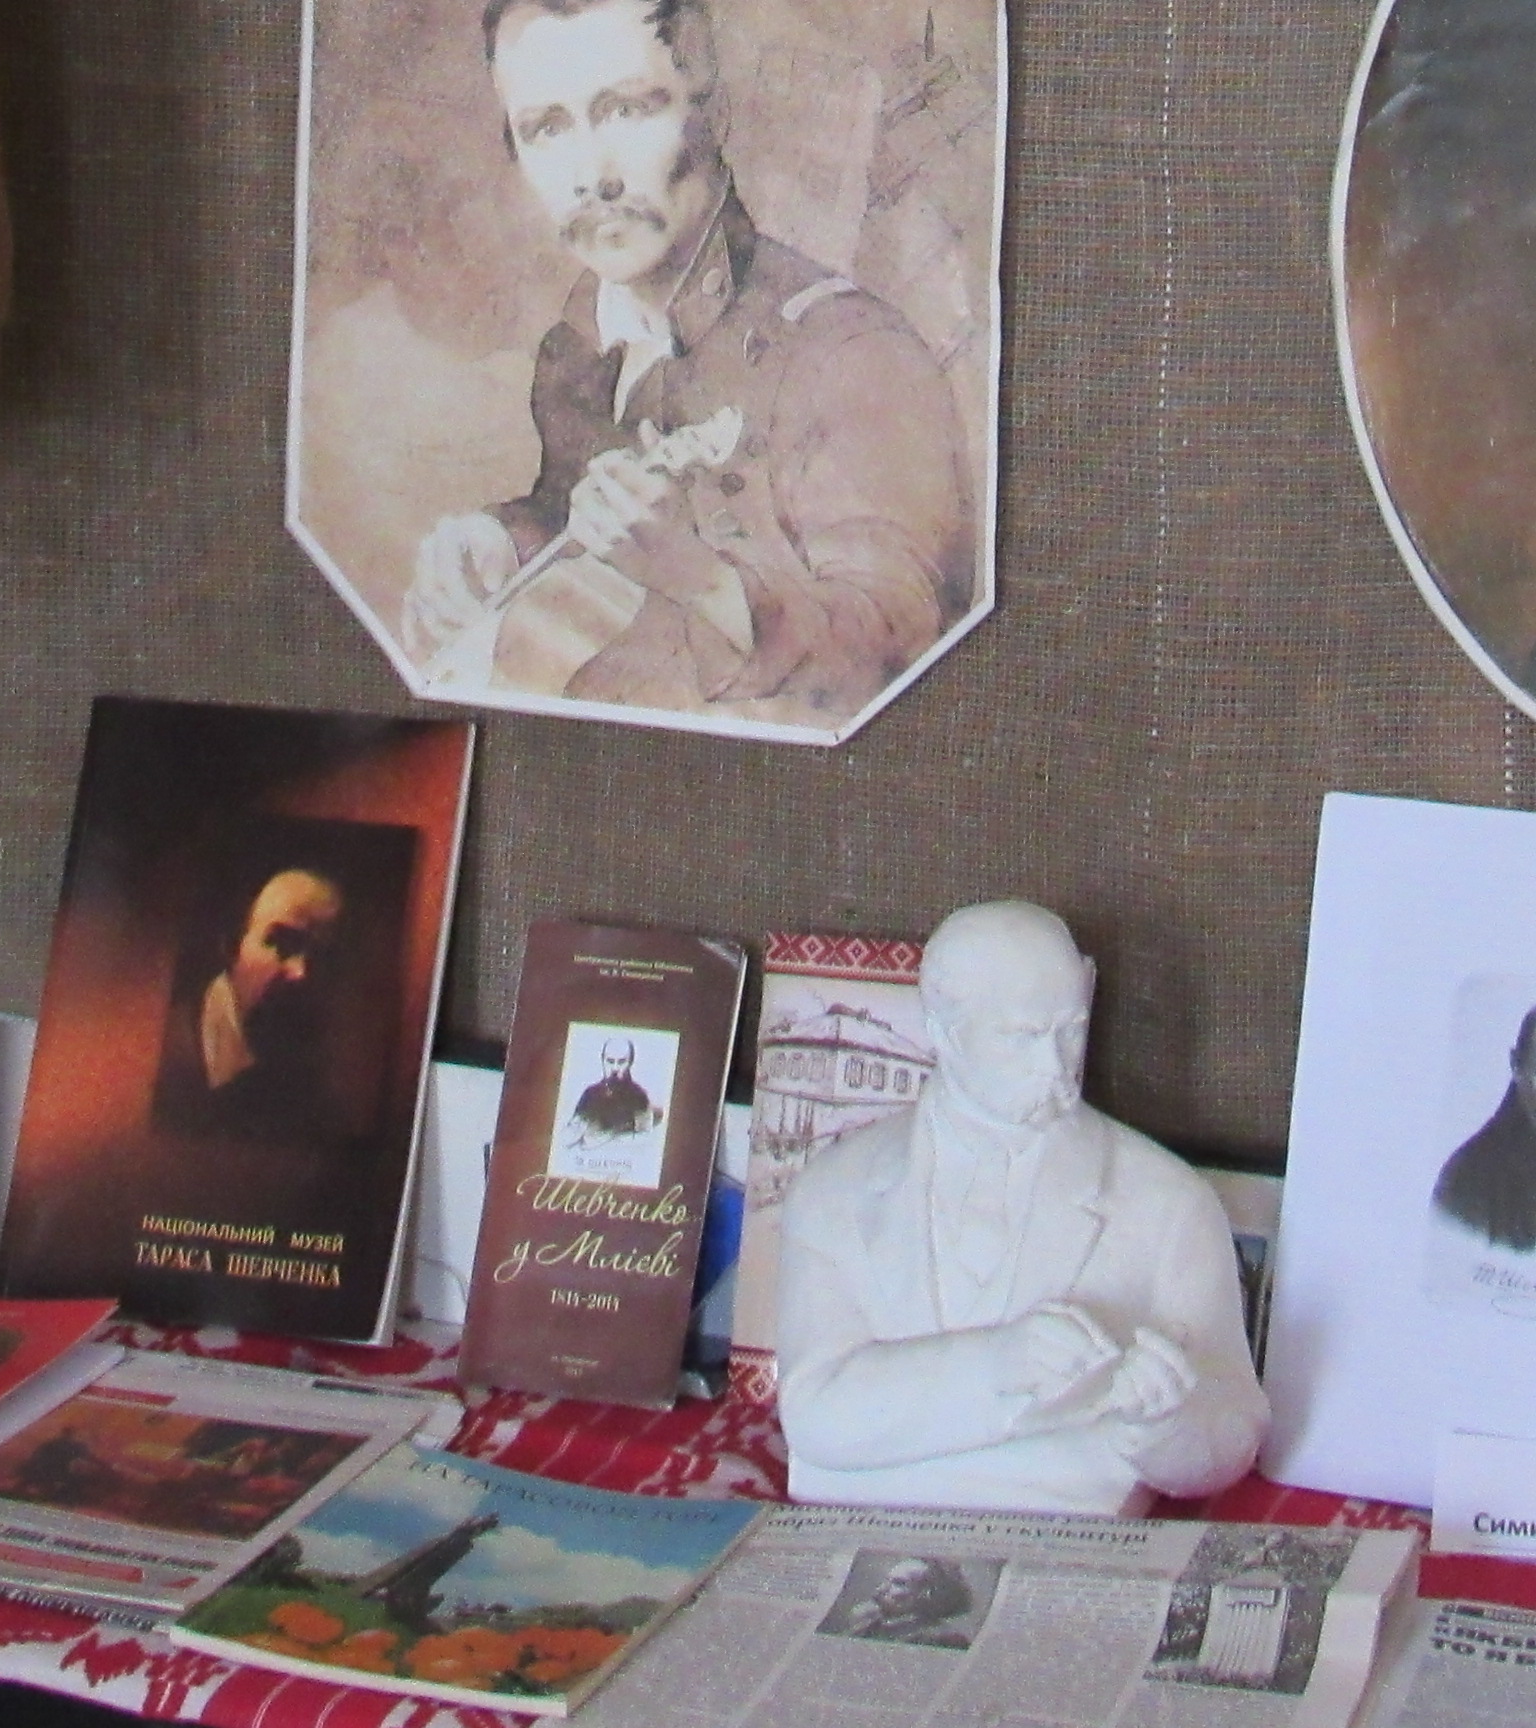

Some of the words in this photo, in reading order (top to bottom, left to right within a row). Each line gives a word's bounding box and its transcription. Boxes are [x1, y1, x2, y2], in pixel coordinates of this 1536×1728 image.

[516, 1173, 689, 1226] Шевченко
[142, 1214, 276, 1246] НАЦІОНАЛЬНИЙ
[289, 1232, 344, 1254] МУЗЕЙ
[134, 1240, 213, 1273] ТАРАСА
[226, 1253, 342, 1289] ШЕВЧЕНКА
[494, 1239, 530, 1283] у
[1431, 1635, 1477, 1657] ТО
